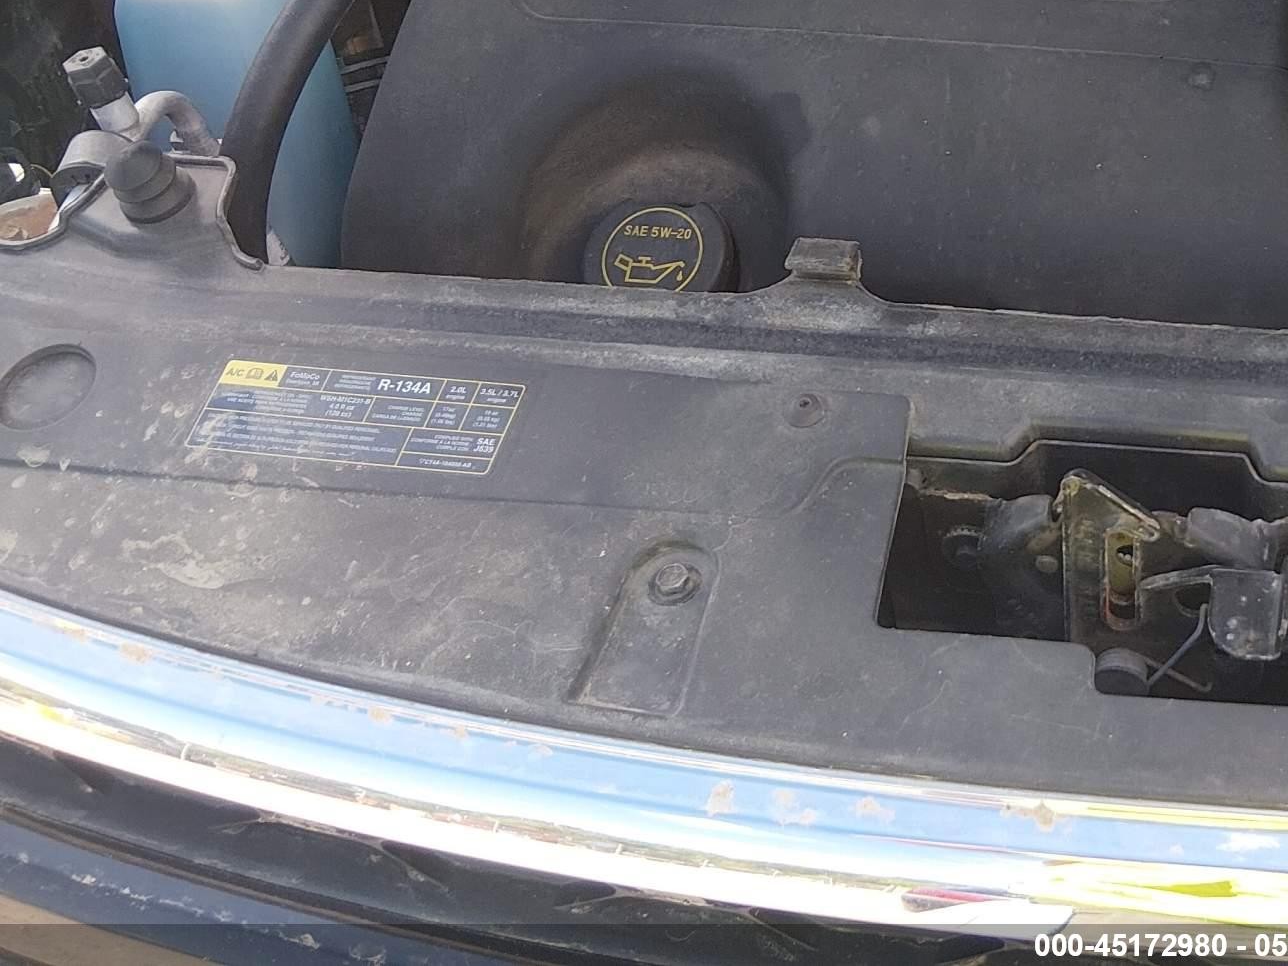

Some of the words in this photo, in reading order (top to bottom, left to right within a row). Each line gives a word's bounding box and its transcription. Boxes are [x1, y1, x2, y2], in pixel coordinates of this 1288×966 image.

[623, 224, 648, 237] SAE
[650, 226, 692, 240] 5W-20
[226, 367, 244, 377] A/C
[376, 378, 431, 395] R-134A
[476, 437, 496, 446] SAE
